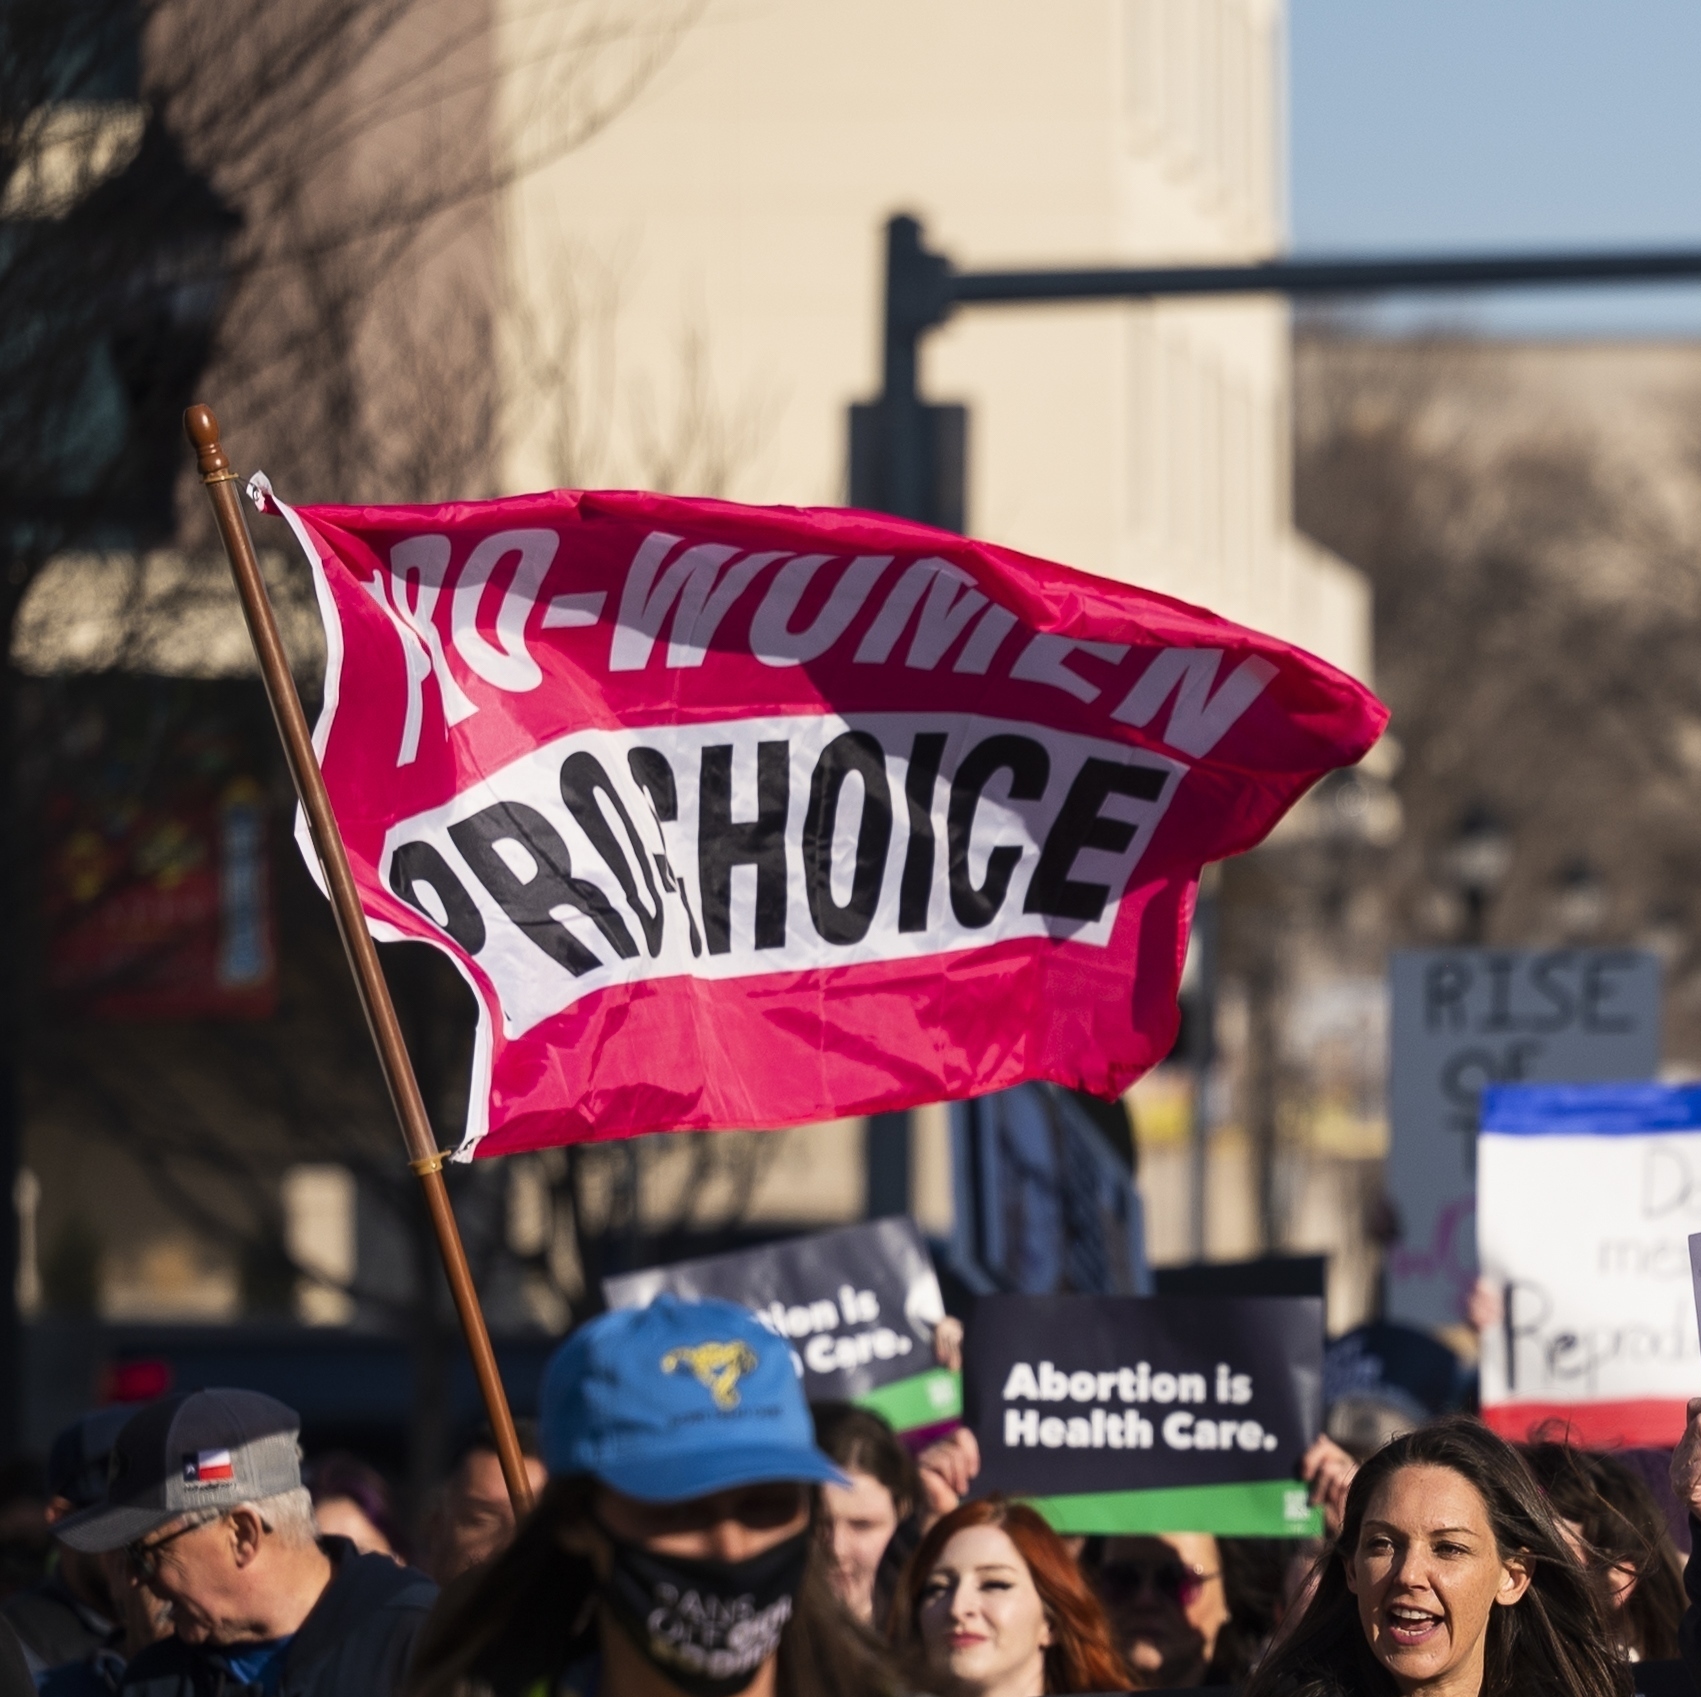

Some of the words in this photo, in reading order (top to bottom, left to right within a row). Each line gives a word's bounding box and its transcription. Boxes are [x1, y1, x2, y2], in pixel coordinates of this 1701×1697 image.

[362, 528, 1280, 768] RO-WOMEN
[1423, 949, 1638, 1036] RISE
[804, 1326, 913, 1374] Care.
[1003, 1361, 1207, 1403] Abortion
[1216, 1363, 1253, 1403] is
[1004, 1408, 1155, 1449] Health
[1163, 1411, 1279, 1452] Care.
